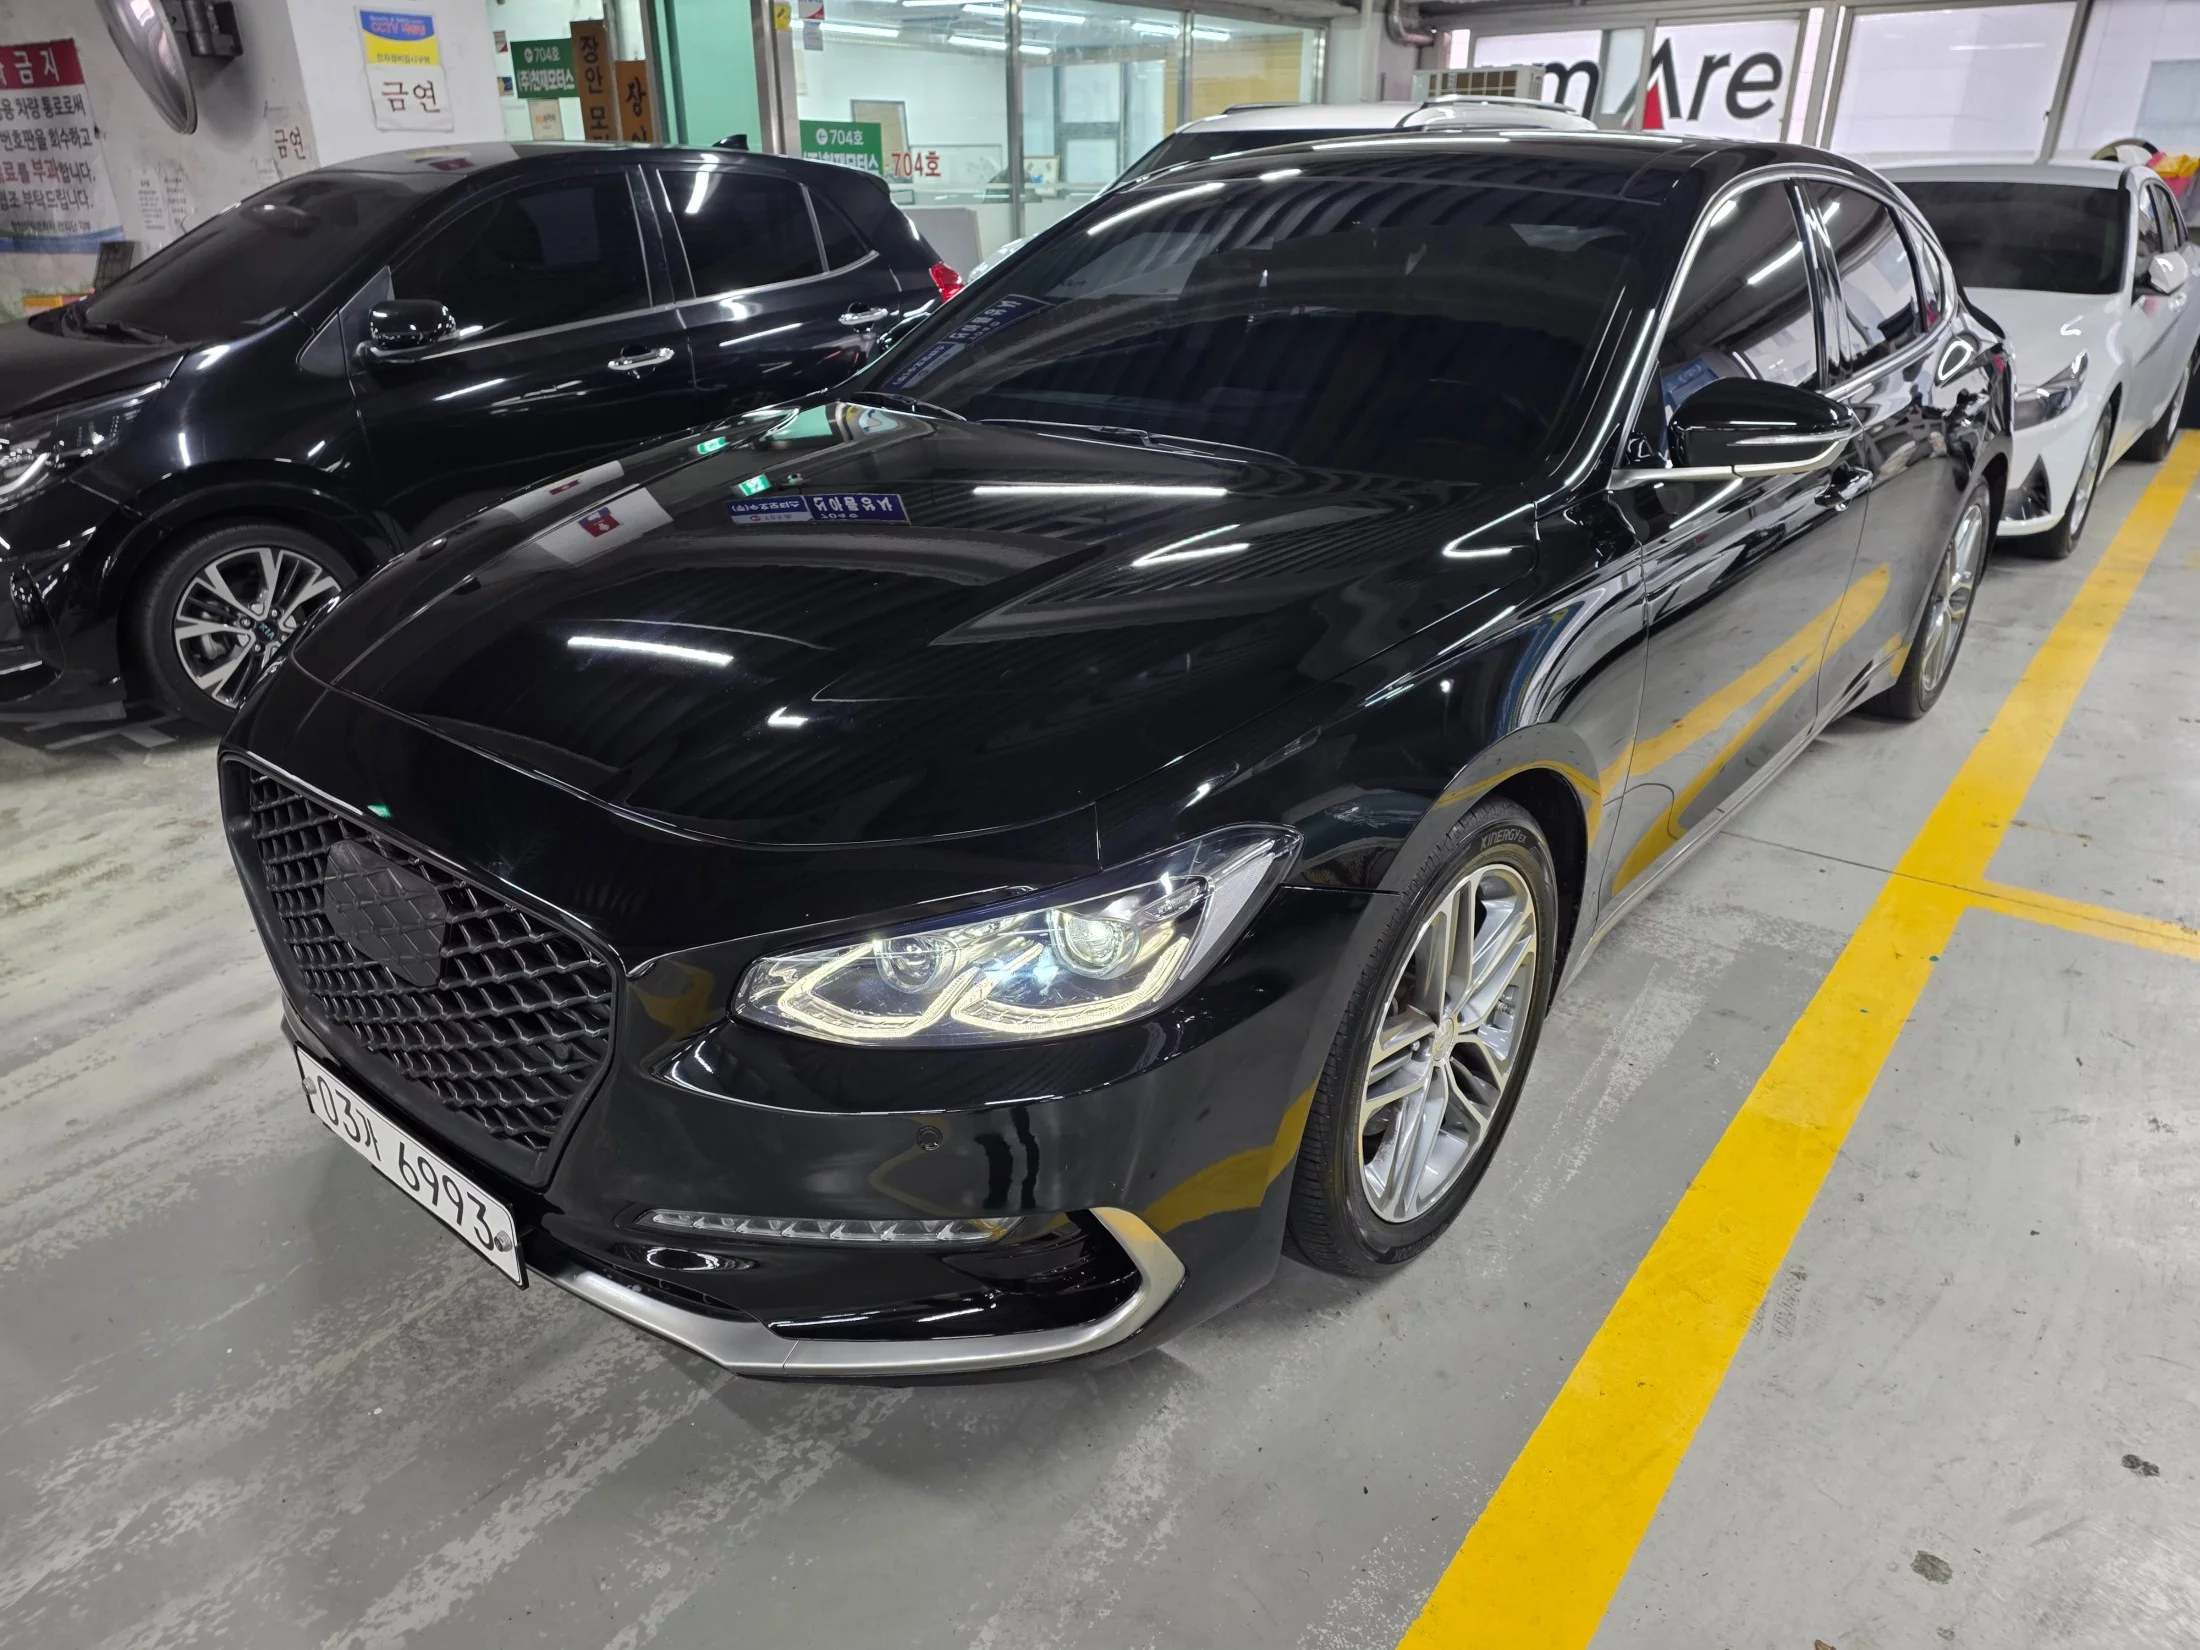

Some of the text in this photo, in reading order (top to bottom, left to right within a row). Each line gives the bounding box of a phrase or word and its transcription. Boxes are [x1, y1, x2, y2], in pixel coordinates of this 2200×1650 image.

[0, 46, 60, 86] 금지
[534, 46, 561, 62] 704호
[381, 80, 441, 113] 금연
[274, 126, 306, 160] 금연
[829, 129, 864, 146] 704호
[0, 160, 31, 184] 료를
[891, 151, 941, 177] 704호
[259, 622, 275, 641] KIA
[1480, 828, 1521, 851] KINERGY
[316, 1075, 494, 1251] 03가 6993
